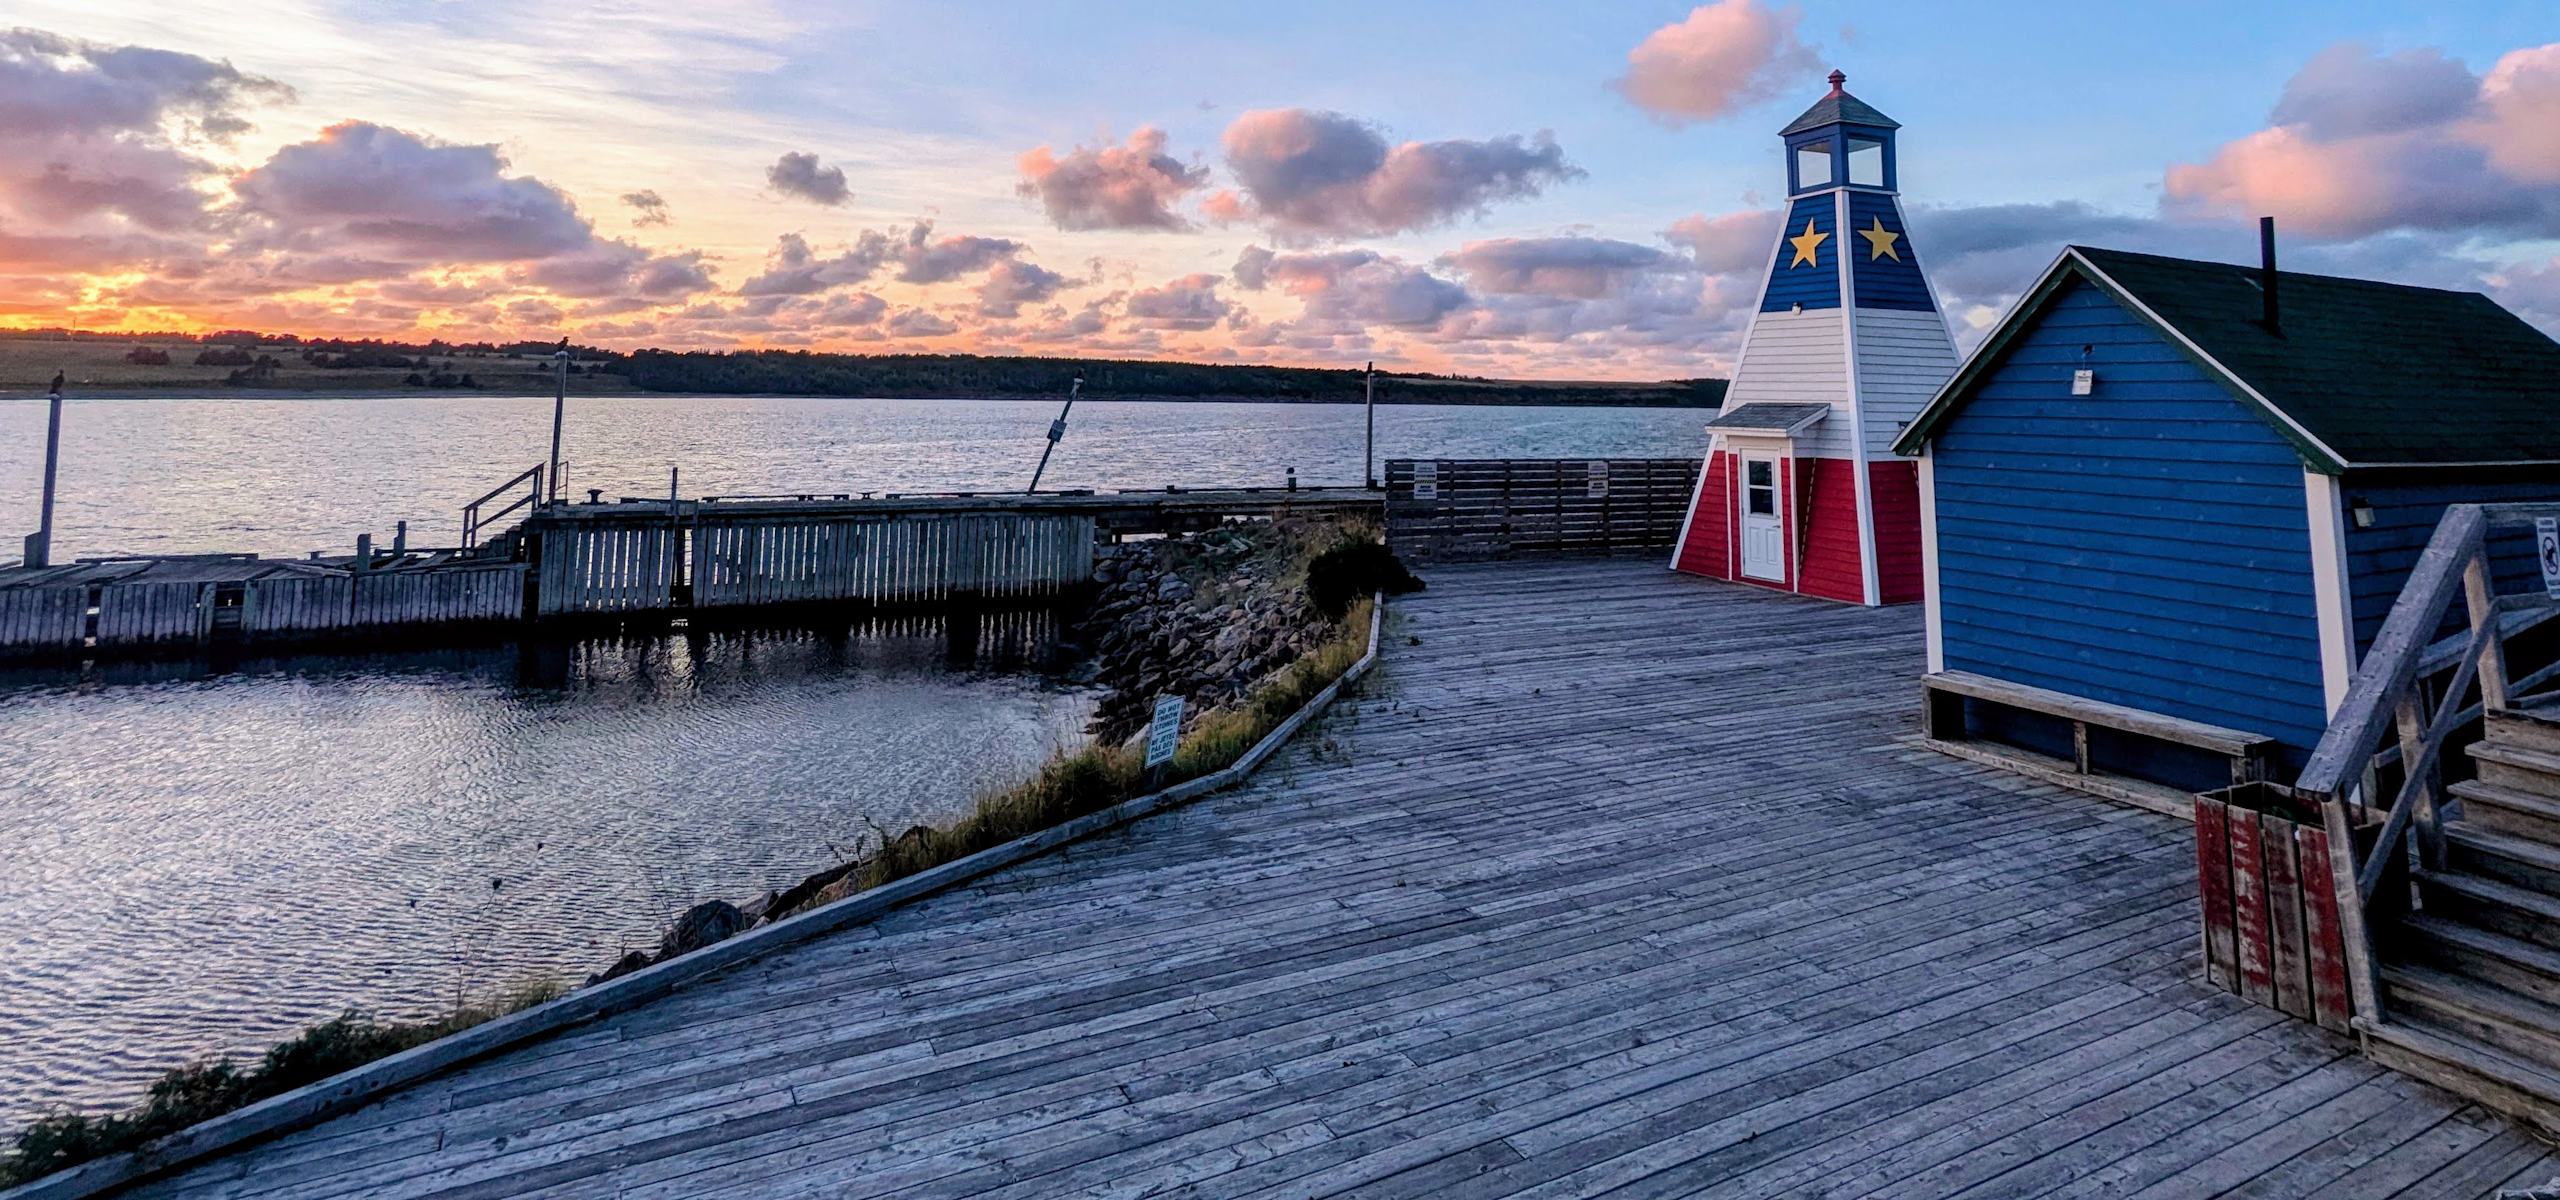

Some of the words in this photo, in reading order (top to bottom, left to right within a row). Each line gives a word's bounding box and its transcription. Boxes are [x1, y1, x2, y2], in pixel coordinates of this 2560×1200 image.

[1168, 703, 1180, 712] NOT
[1156, 712, 1178, 722] THROW
[1154, 718, 1178, 731] STONES
